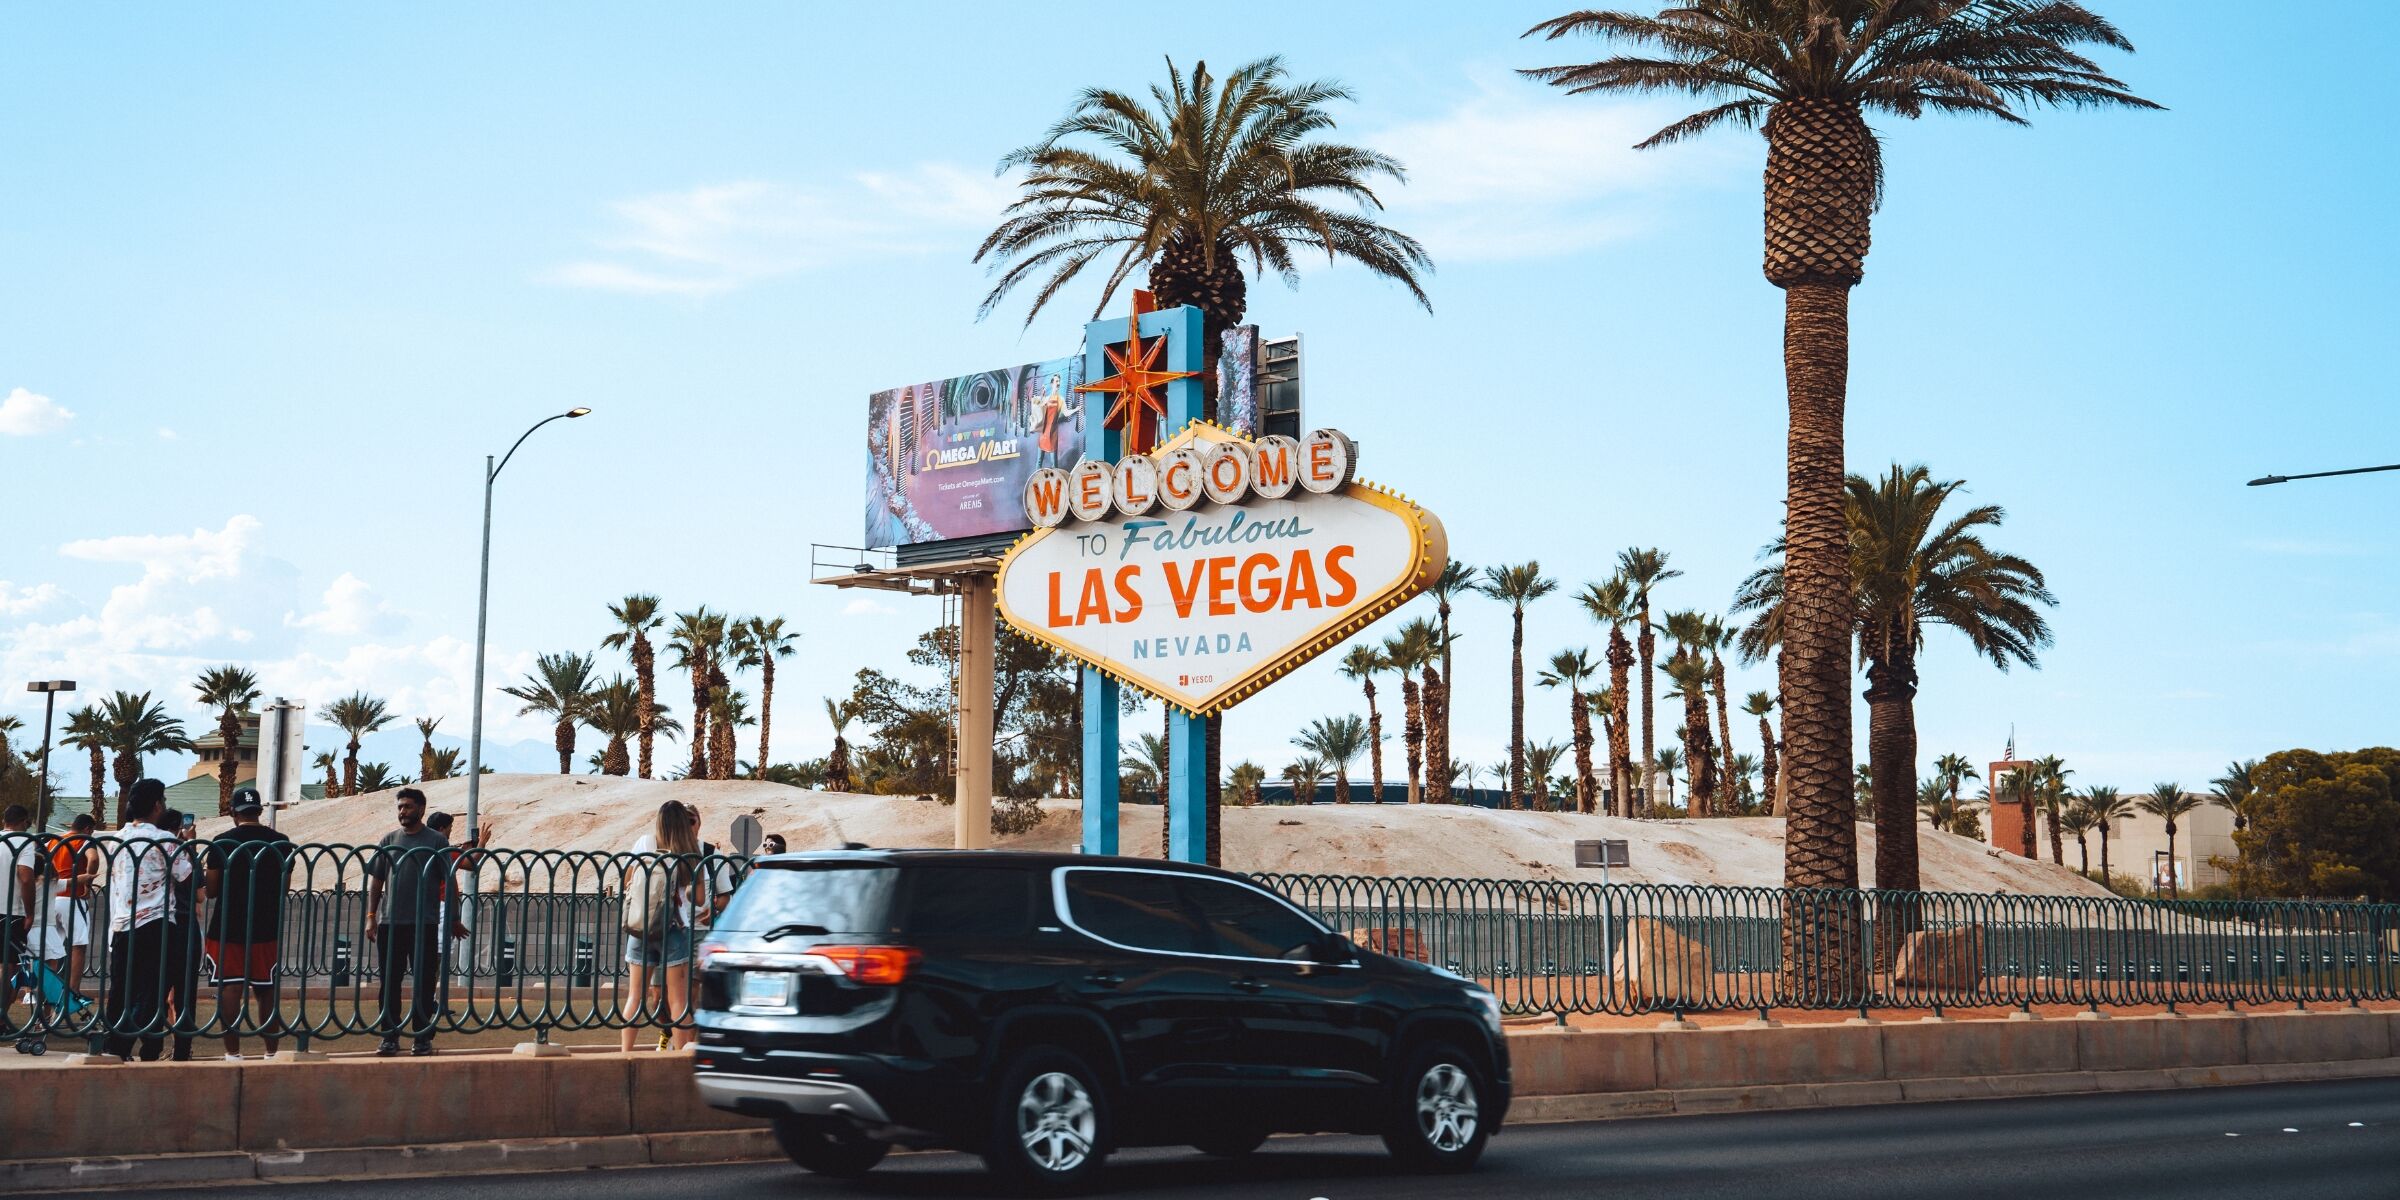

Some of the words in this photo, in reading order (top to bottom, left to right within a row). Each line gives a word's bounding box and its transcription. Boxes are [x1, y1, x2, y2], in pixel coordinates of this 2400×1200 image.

[938, 483, 956, 491] Tickets
[1032, 442, 1333, 517] WELCOME
[960, 500, 982, 510] AREA15
[1076, 534, 1107, 557] TO
[1119, 510, 1314, 561] Fabulous
[1048, 565, 1143, 628] LAS
[1162, 545, 1357, 619] VEGAS
[1133, 632, 1252, 659] NEVADA
[1191, 675, 1213, 684] YESCO
